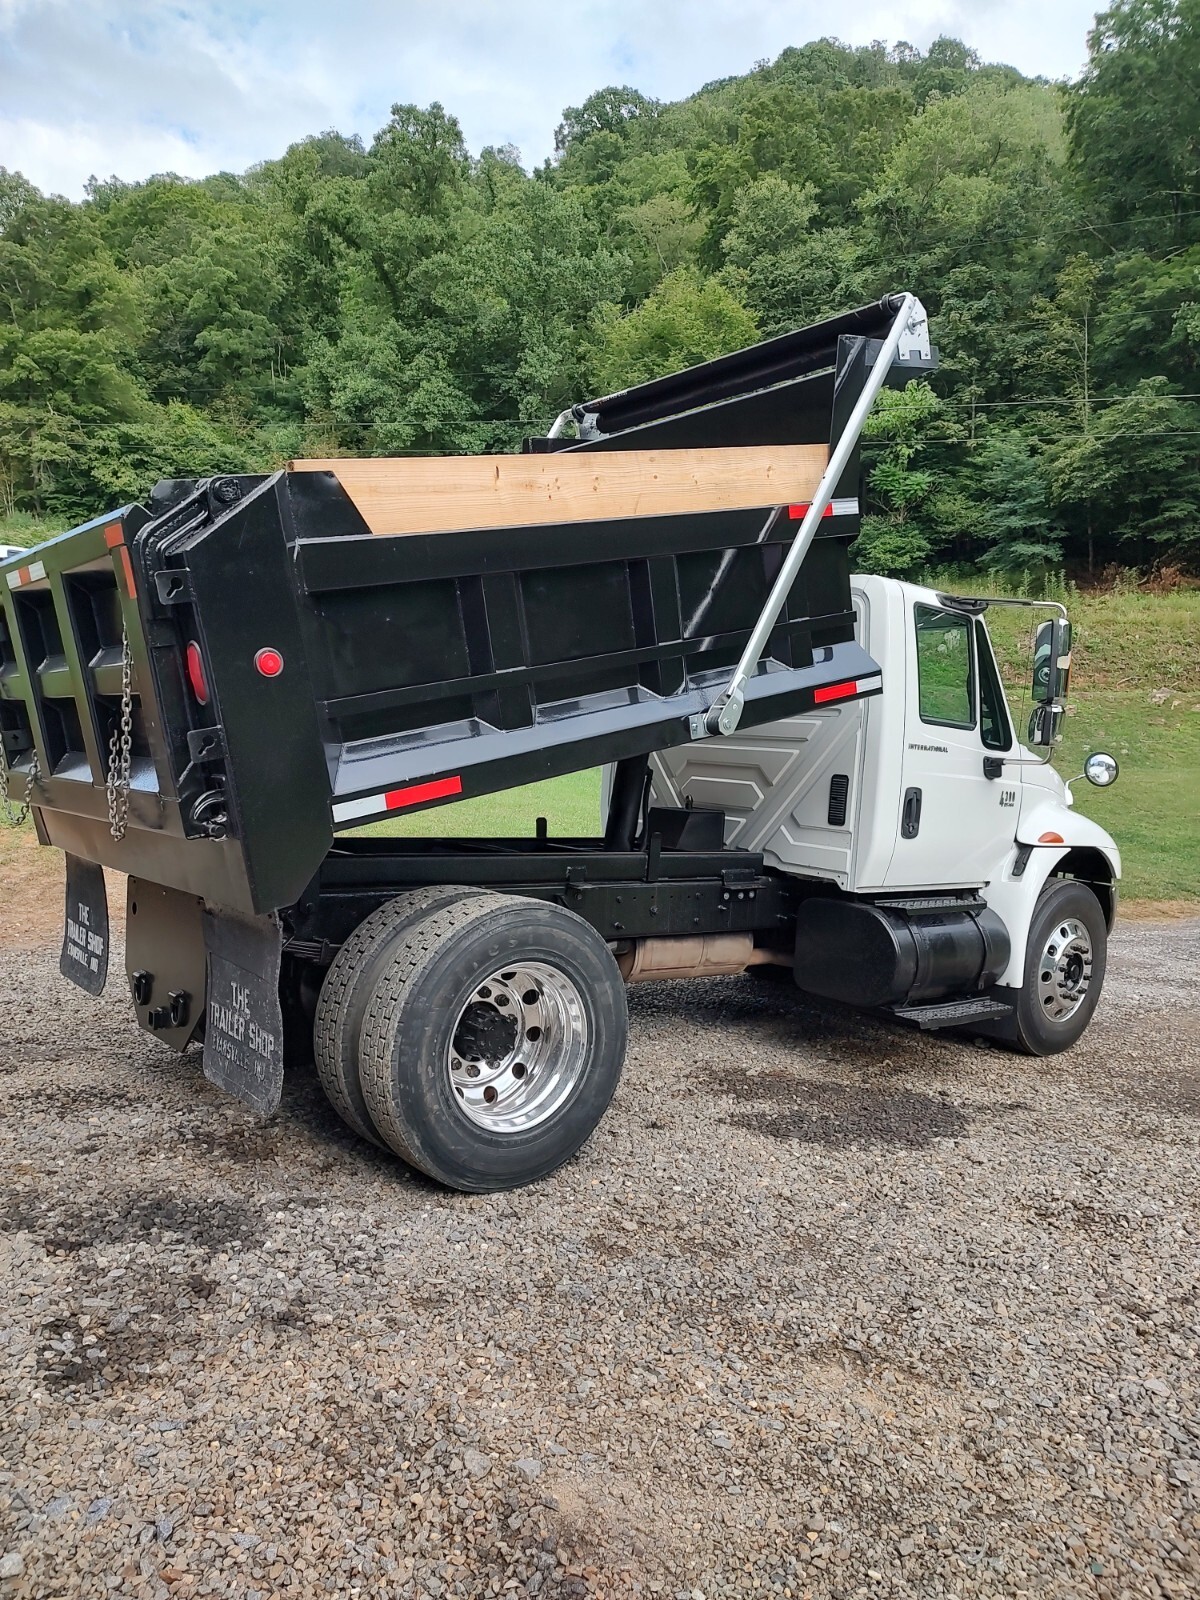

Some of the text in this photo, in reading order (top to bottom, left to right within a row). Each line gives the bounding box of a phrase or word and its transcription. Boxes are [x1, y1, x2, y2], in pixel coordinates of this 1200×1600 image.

[908, 743, 948, 753] INTERNATIONAL
[78, 902, 90, 926] THE
[88, 930, 104, 956] SHOP
[230, 981, 251, 1014] THE
[210, 1001, 275, 1060] TRAILER SHOP
